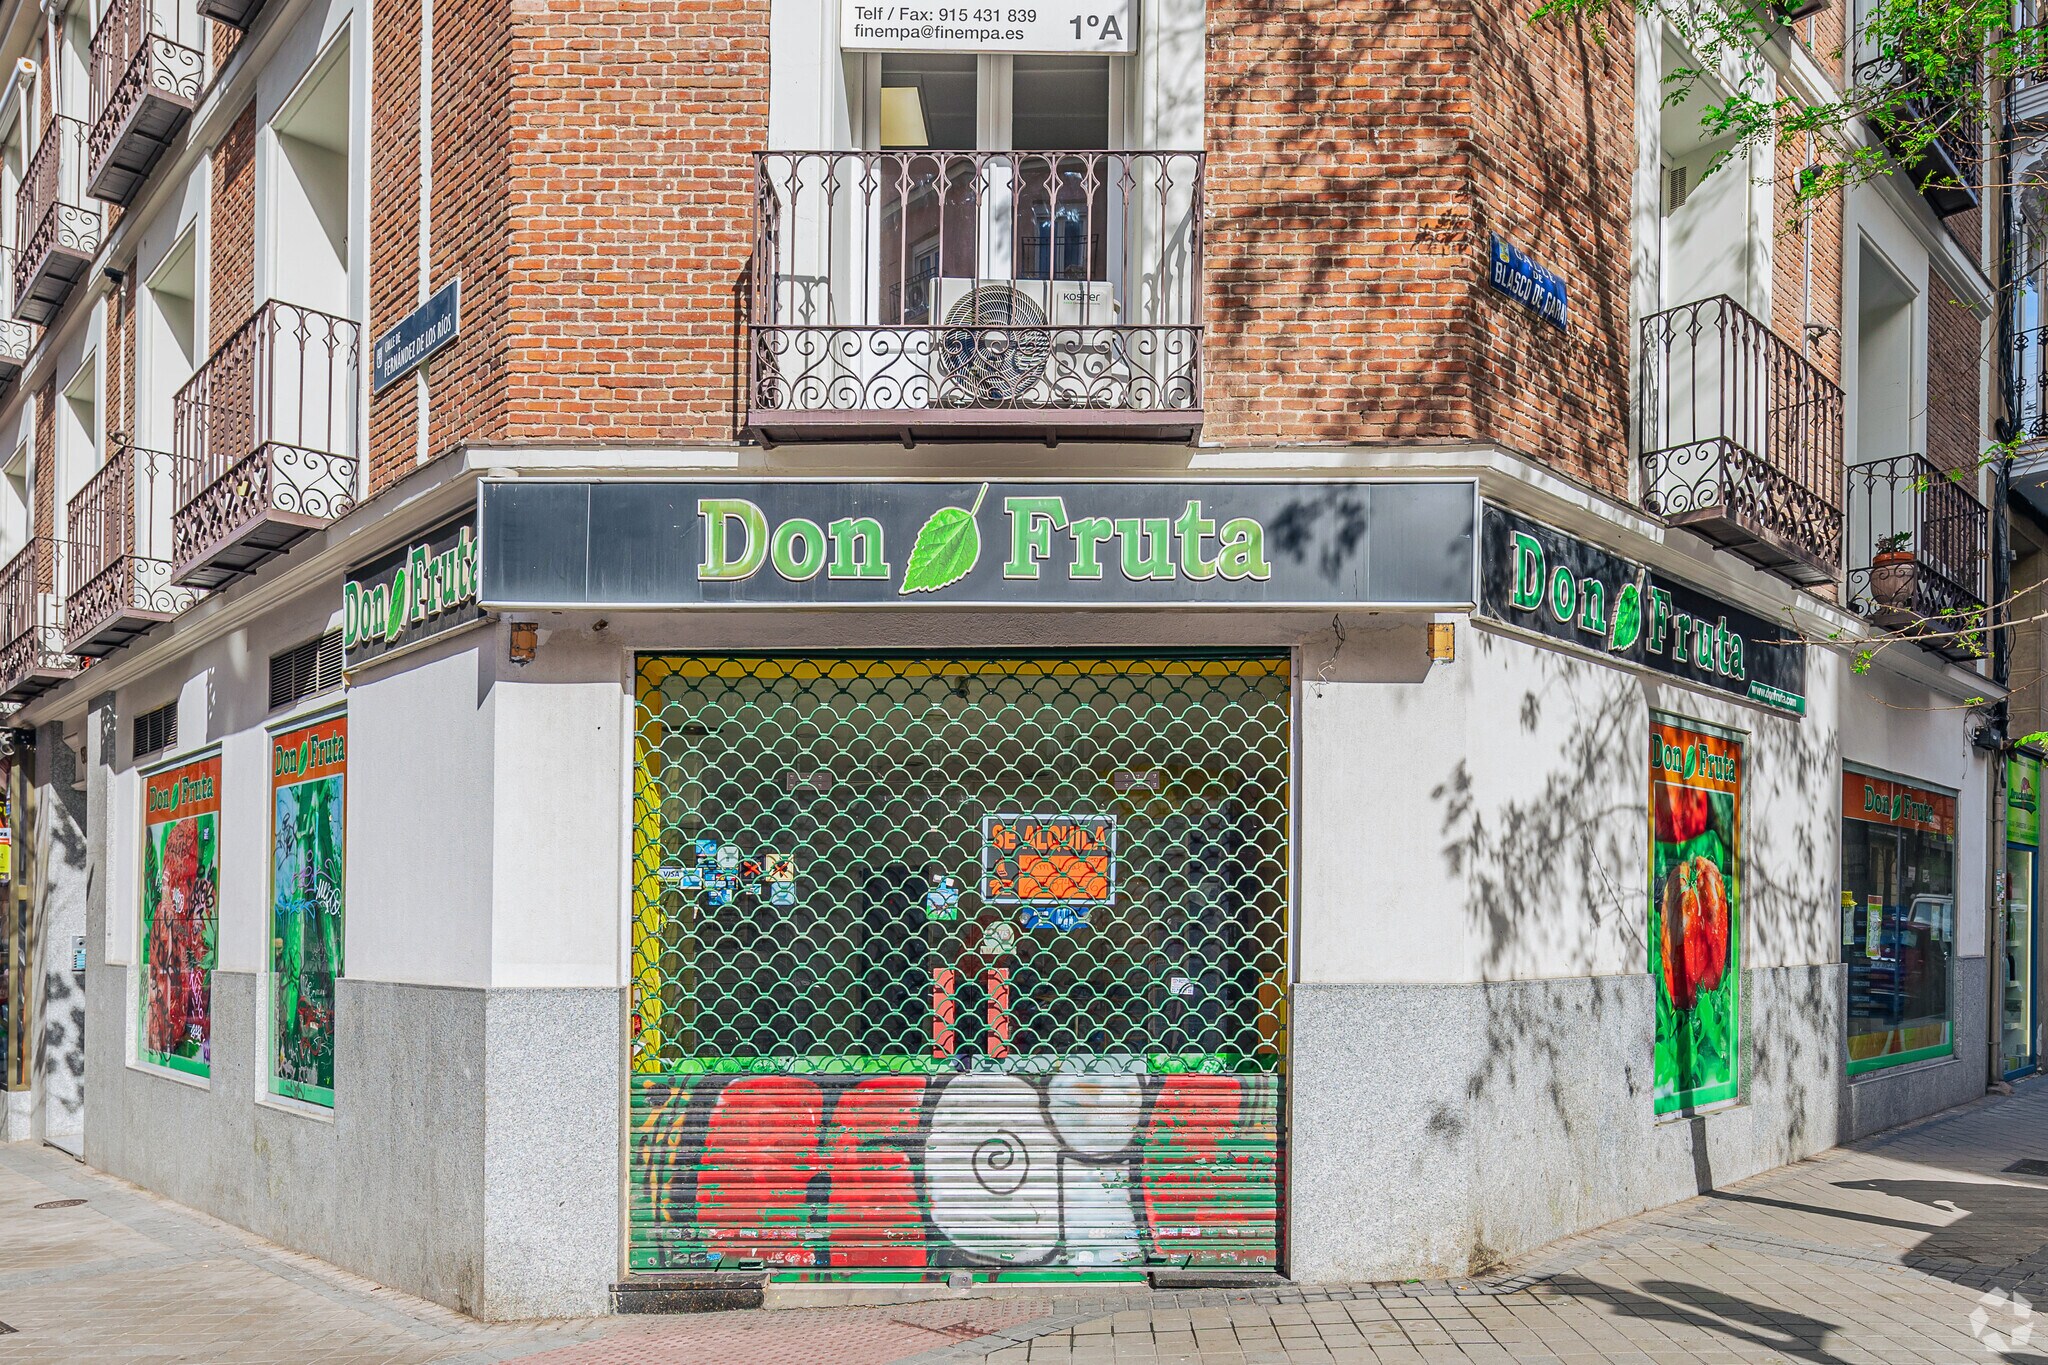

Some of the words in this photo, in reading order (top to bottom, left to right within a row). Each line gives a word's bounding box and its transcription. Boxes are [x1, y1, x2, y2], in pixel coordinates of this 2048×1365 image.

[854, 24, 1024, 42] finempa@finempa.es
[855, 6, 883, 20] Telf
[887, 7, 894, 21] /
[900, 7, 933, 21] Fax:
[939, 8, 968, 22] 915
[973, 8, 1001, 22] 431
[1007, 8, 1037, 23] 839
[1069, 15, 1123, 40] 1ºA
[1495, 261, 1533, 301] BLASCO
[1531, 283, 1545, 308] DE
[1533, 270, 1544, 284] DE
[384, 334, 396, 353] CALLE
[395, 331, 402, 345] DE
[384, 340, 416, 379] FERNÁNDEZ
[416, 333, 425, 354] DE
[425, 324, 436, 348] LOS
[437, 313, 452, 340] RÍOS
[697, 497, 891, 582] Don
[1003, 495, 1271, 582] Fruta
[343, 580, 388, 649] Don
[1509, 529, 1607, 637] Don
[1646, 584, 1745, 681] Fruta
[275, 745, 297, 777] Don
[310, 730, 345, 768] Fruta
[1652, 733, 1683, 773] Don
[1698, 743, 1736, 783] Fruta
[149, 786, 169, 813] Don
[181, 772, 214, 805] Fruta
[1864, 784, 1890, 816] Don
[1903, 793, 1934, 823] Fruta
[992, 824, 1017, 850] SE
[1022, 824, 1107, 852] ALQUILA
